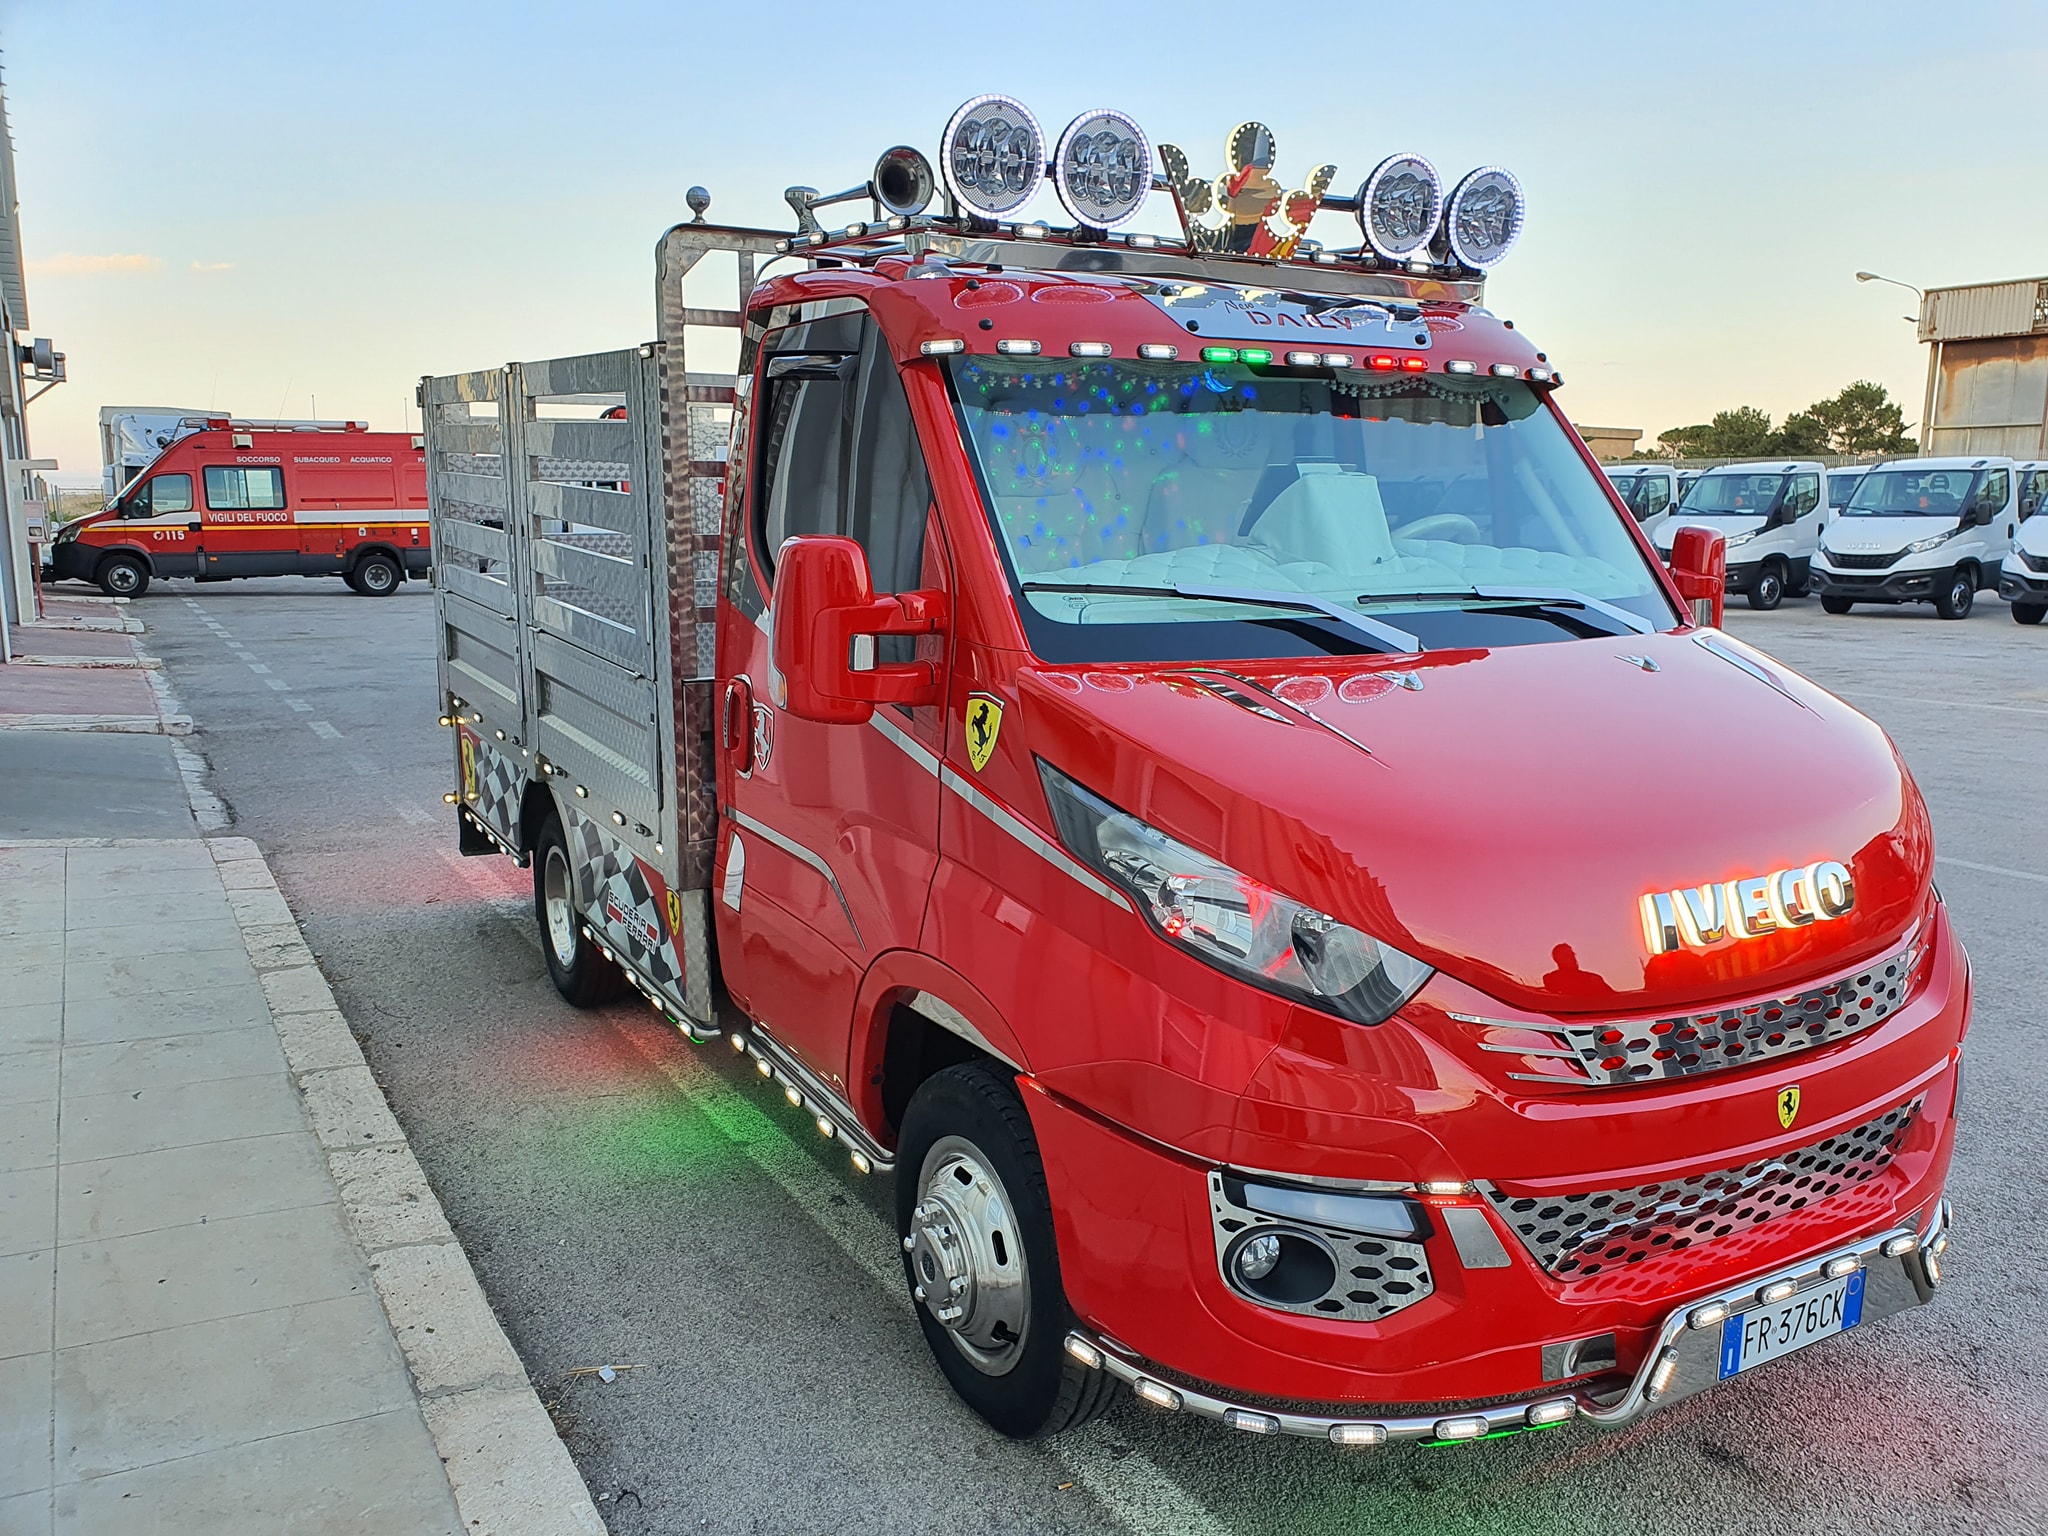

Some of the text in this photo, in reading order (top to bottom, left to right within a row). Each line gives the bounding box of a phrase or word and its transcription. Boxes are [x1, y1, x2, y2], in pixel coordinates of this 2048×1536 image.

[1224, 299, 1254, 314] New
[1245, 310, 1352, 330] DAILY
[209, 512, 288, 523] VIGILI DEL FUOCO
[165, 530, 185, 541] 115
[608, 890, 647, 931] SCUDERIA
[1639, 861, 1856, 954] IVECO
[621, 916, 657, 954] FERRARI
[1743, 1286, 1846, 1360] FR 376CK
